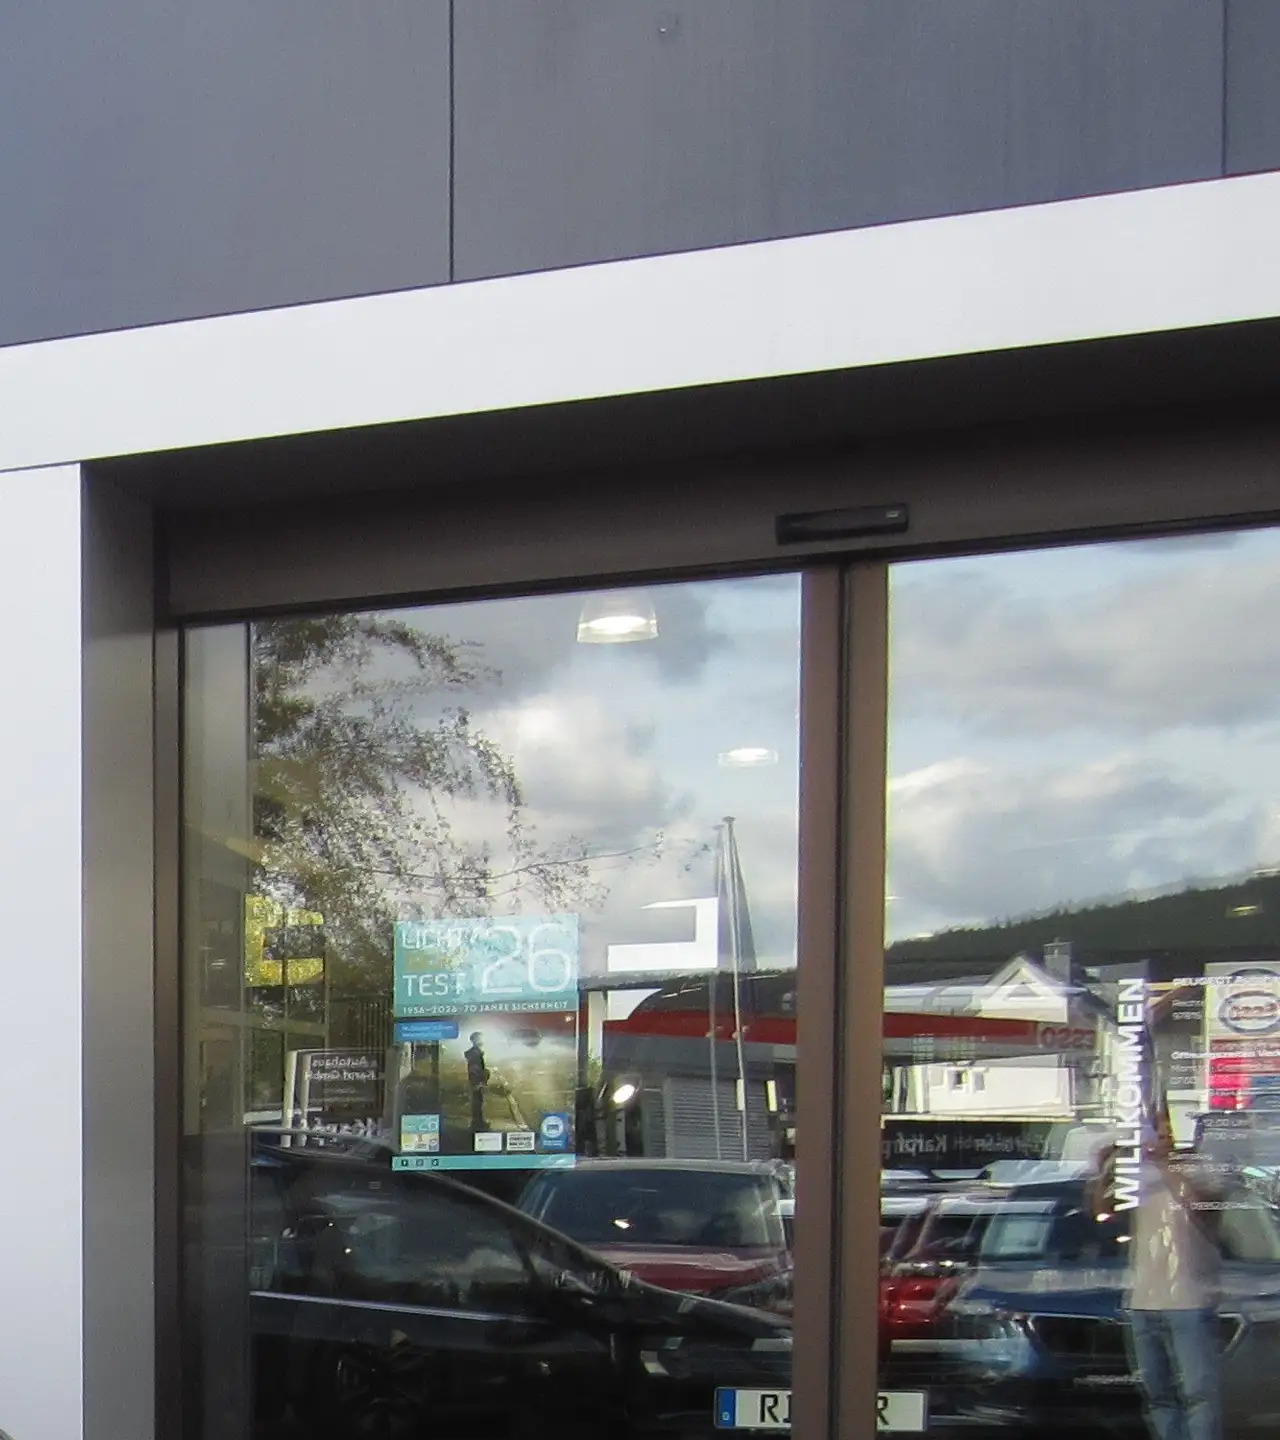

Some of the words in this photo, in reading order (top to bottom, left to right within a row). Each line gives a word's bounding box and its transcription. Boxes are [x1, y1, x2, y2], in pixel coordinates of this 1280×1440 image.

[481, 923, 572, 993] 26
[402, 973, 467, 996] TEST
[511, 1000, 569, 1011] SICHERHEIT
[1113, 978, 1144, 1212] WILLKOMMEN
